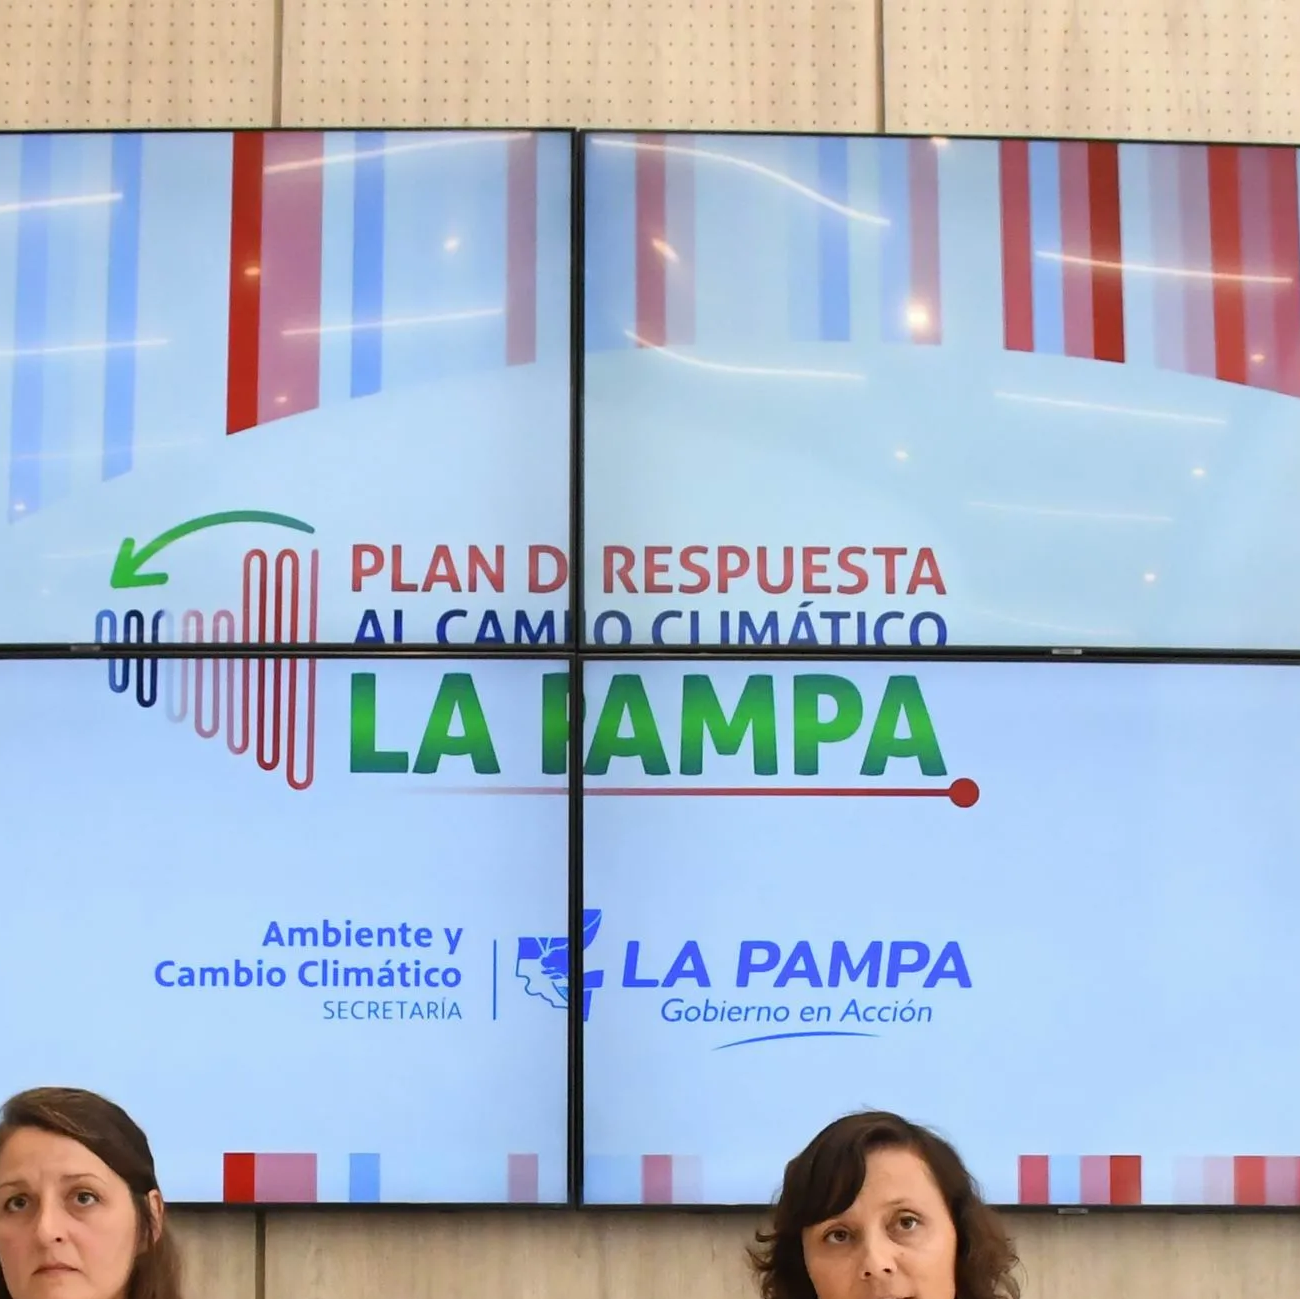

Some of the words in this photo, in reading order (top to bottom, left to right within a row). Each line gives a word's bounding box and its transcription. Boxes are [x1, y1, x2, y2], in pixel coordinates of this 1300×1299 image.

[351, 543, 505, 593] PLAN
[527, 544, 570, 594] D
[602, 544, 948, 595] RESPUESTA
[435, 608, 633, 646] CAMO
[349, 671, 502, 775] LA
[261, 919, 434, 949] Ambiente
[443, 926, 464, 955] y
[154, 958, 287, 989] Cambio
[297, 956, 463, 989] Climático
[621, 939, 712, 989] LA
[735, 939, 973, 989] PAMPA
[323, 996, 463, 1020] SECRETARÍA
[660, 997, 790, 1023] Gobierno
[799, 1005, 832, 1023] en
[839, 997, 933, 1023] Acción
